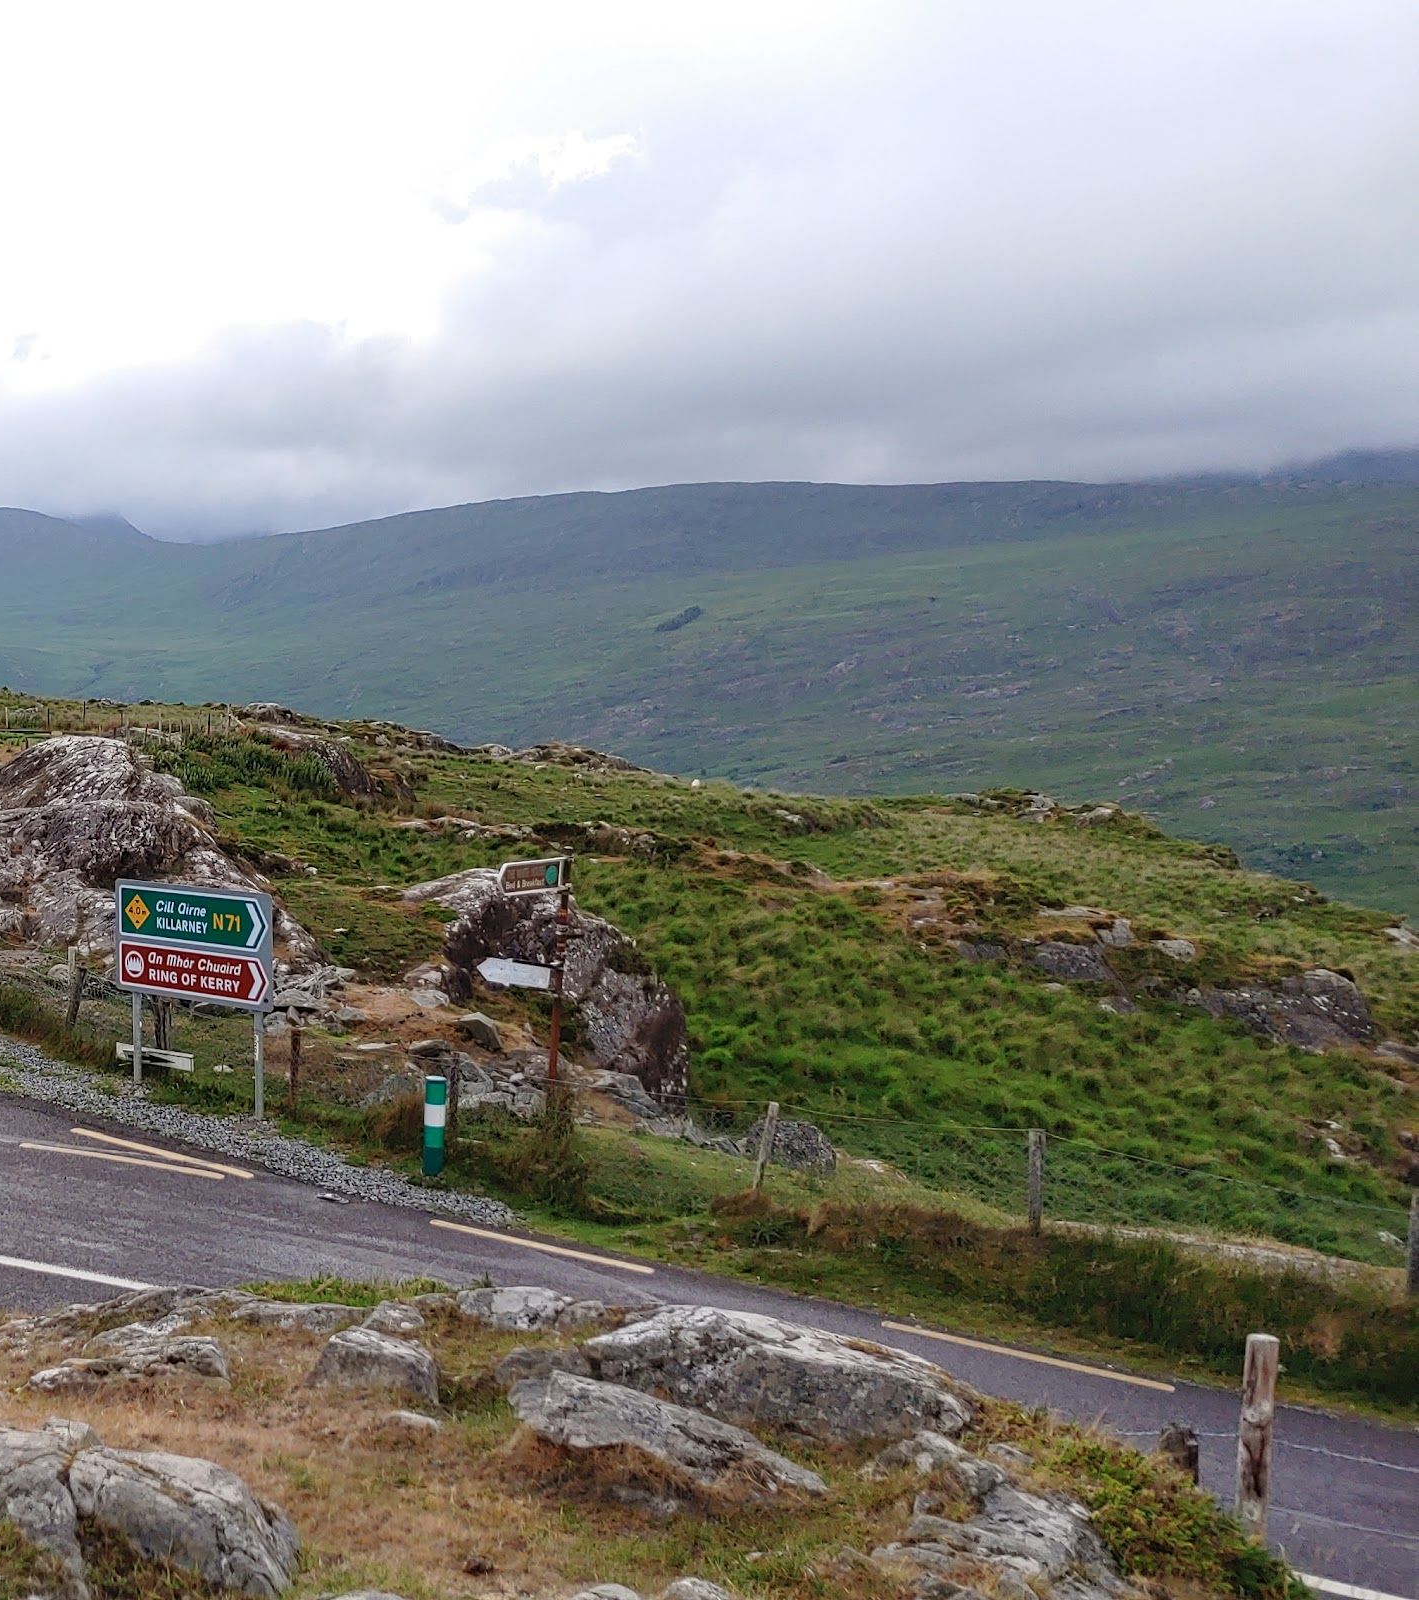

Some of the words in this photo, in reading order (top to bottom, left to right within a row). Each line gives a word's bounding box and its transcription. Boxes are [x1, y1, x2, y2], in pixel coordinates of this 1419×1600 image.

[155, 900, 175, 914] Cill
[156, 916, 208, 935] KILLARNEY
[197, 958, 242, 977] Chuaird
[148, 968, 178, 985] RING
[181, 972, 198, 987] OF
[200, 975, 241, 994] KERRY
